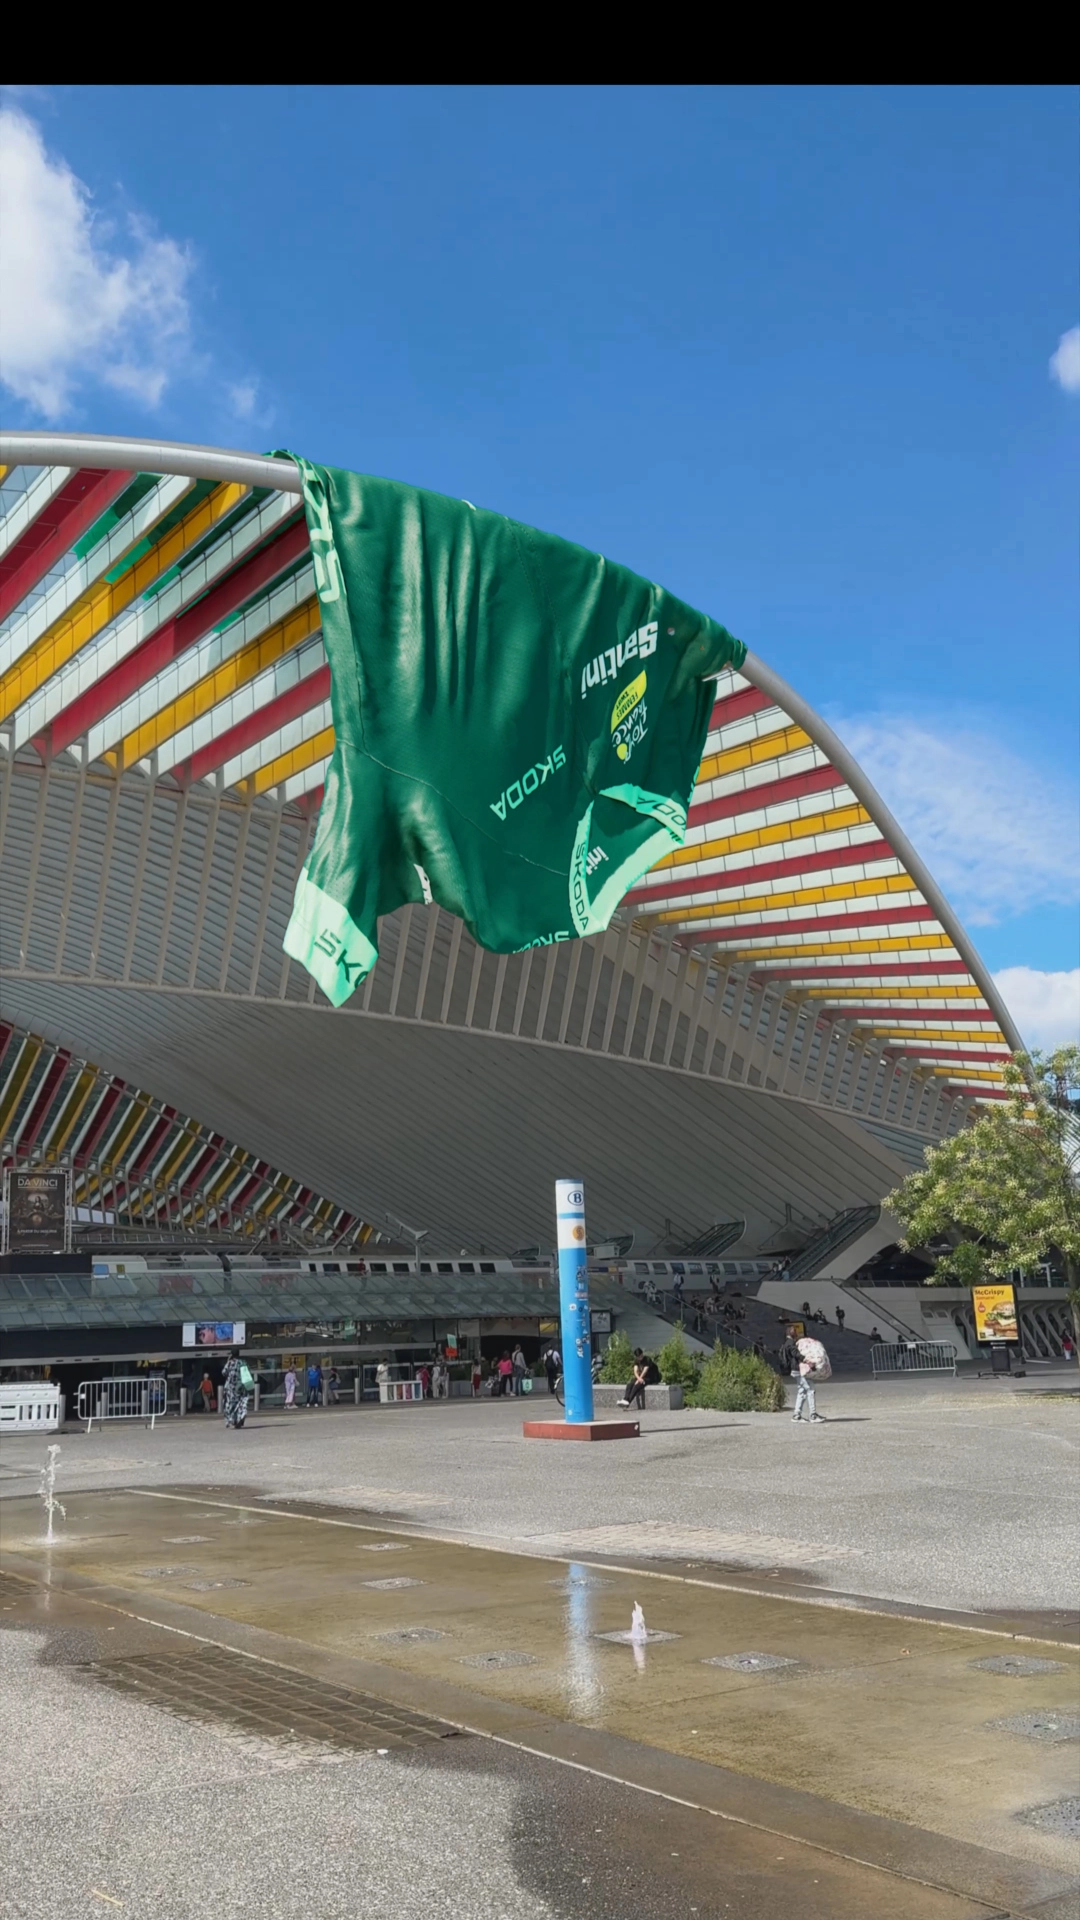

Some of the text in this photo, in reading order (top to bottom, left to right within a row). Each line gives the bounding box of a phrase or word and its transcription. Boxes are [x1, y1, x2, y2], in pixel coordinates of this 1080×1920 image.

[581, 621, 658, 700] Santini
[615, 691, 639, 720] FEMMES
[17, 1178, 58, 1187] DA VINCI
